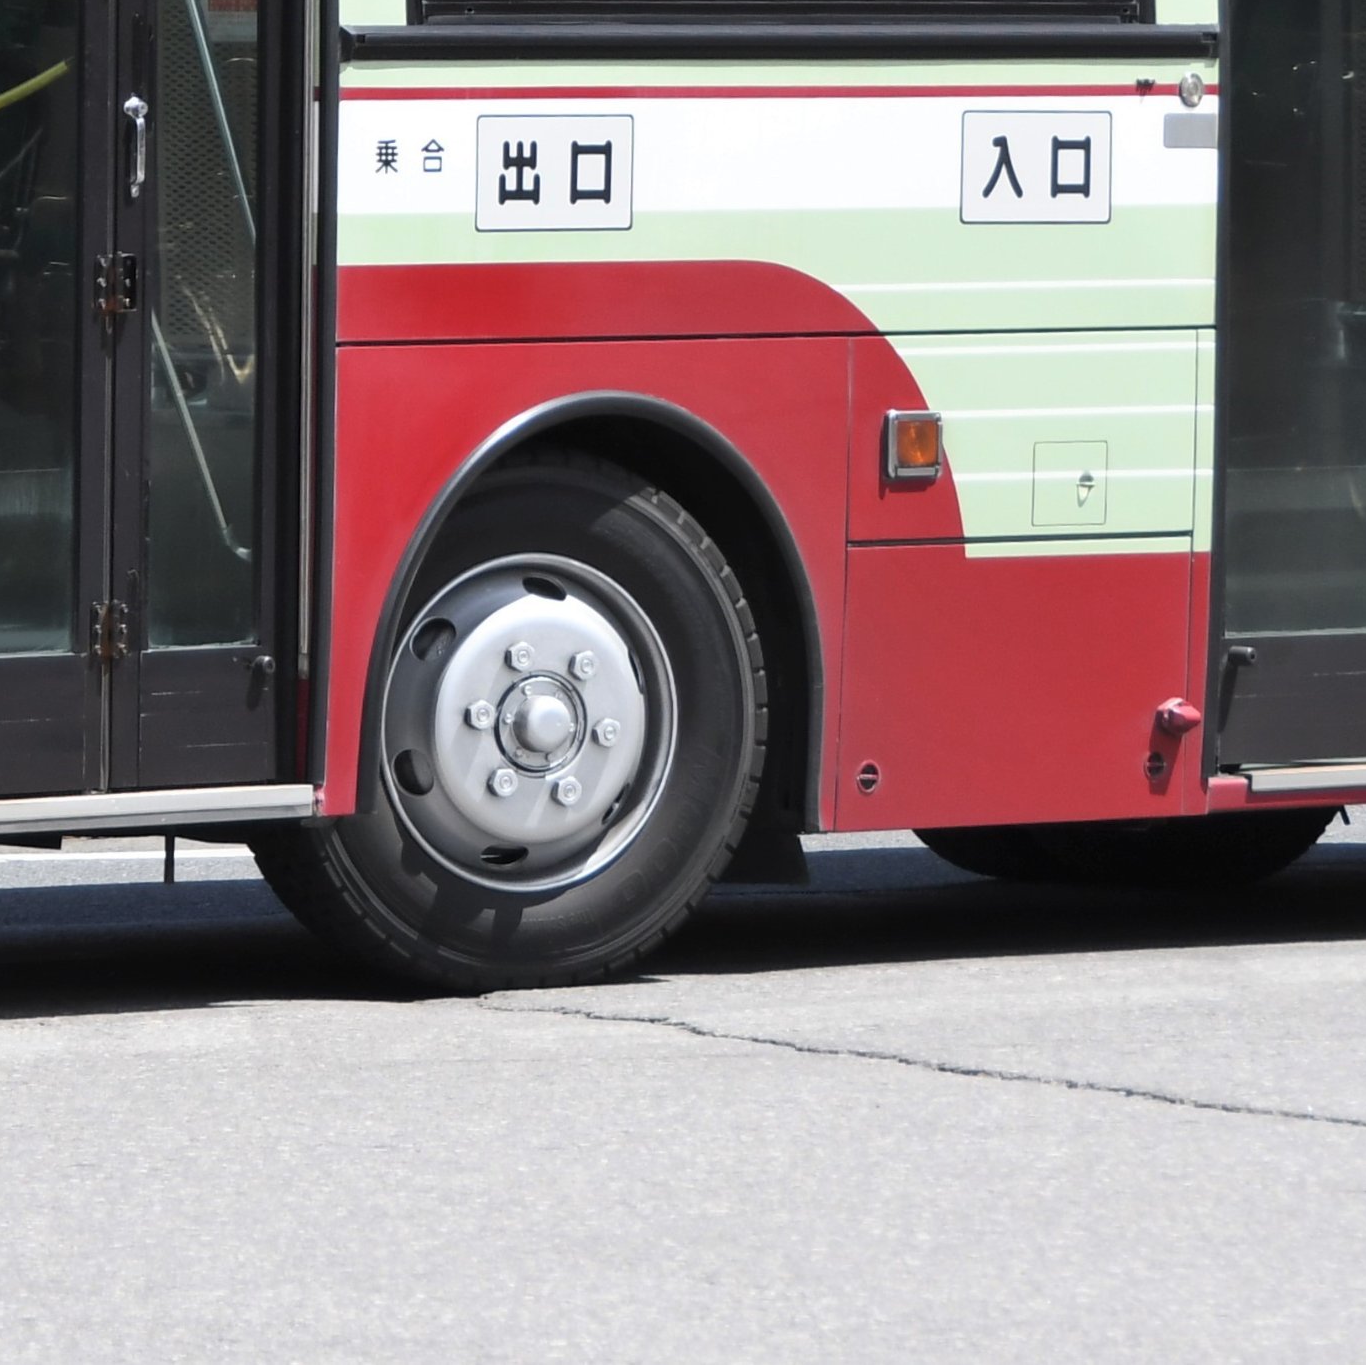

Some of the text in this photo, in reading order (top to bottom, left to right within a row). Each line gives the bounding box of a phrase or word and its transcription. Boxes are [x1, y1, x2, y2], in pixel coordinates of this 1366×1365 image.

[375, 138, 445, 174] 乗合
[498, 139, 613, 205] 出口
[981, 135, 1092, 199] 入口
